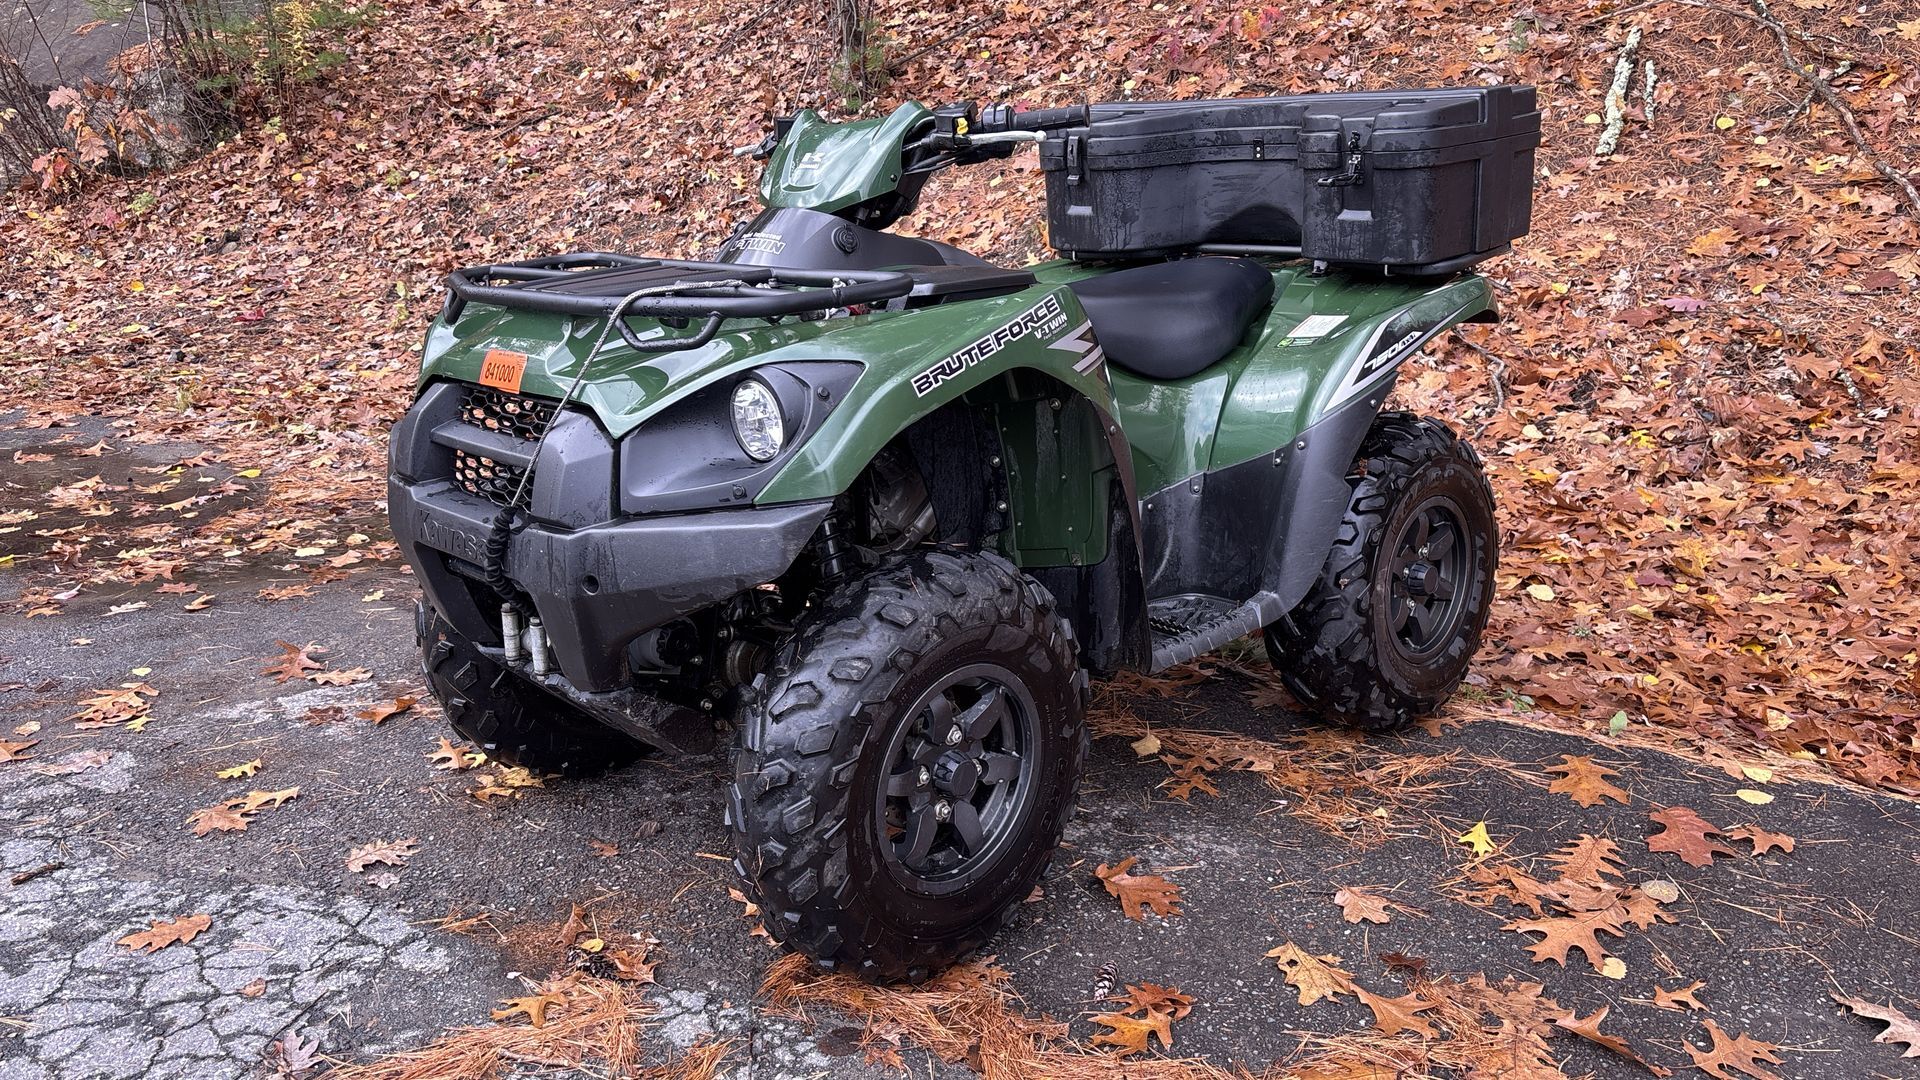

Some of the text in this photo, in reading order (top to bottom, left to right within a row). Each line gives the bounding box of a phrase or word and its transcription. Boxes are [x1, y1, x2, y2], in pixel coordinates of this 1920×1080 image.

[1034, 312, 1068, 339] V-TWIN
[911, 294, 1061, 398] BRUTE FORCE
[1364, 343, 1399, 370] 750
[484, 362, 515, 383] 841000
